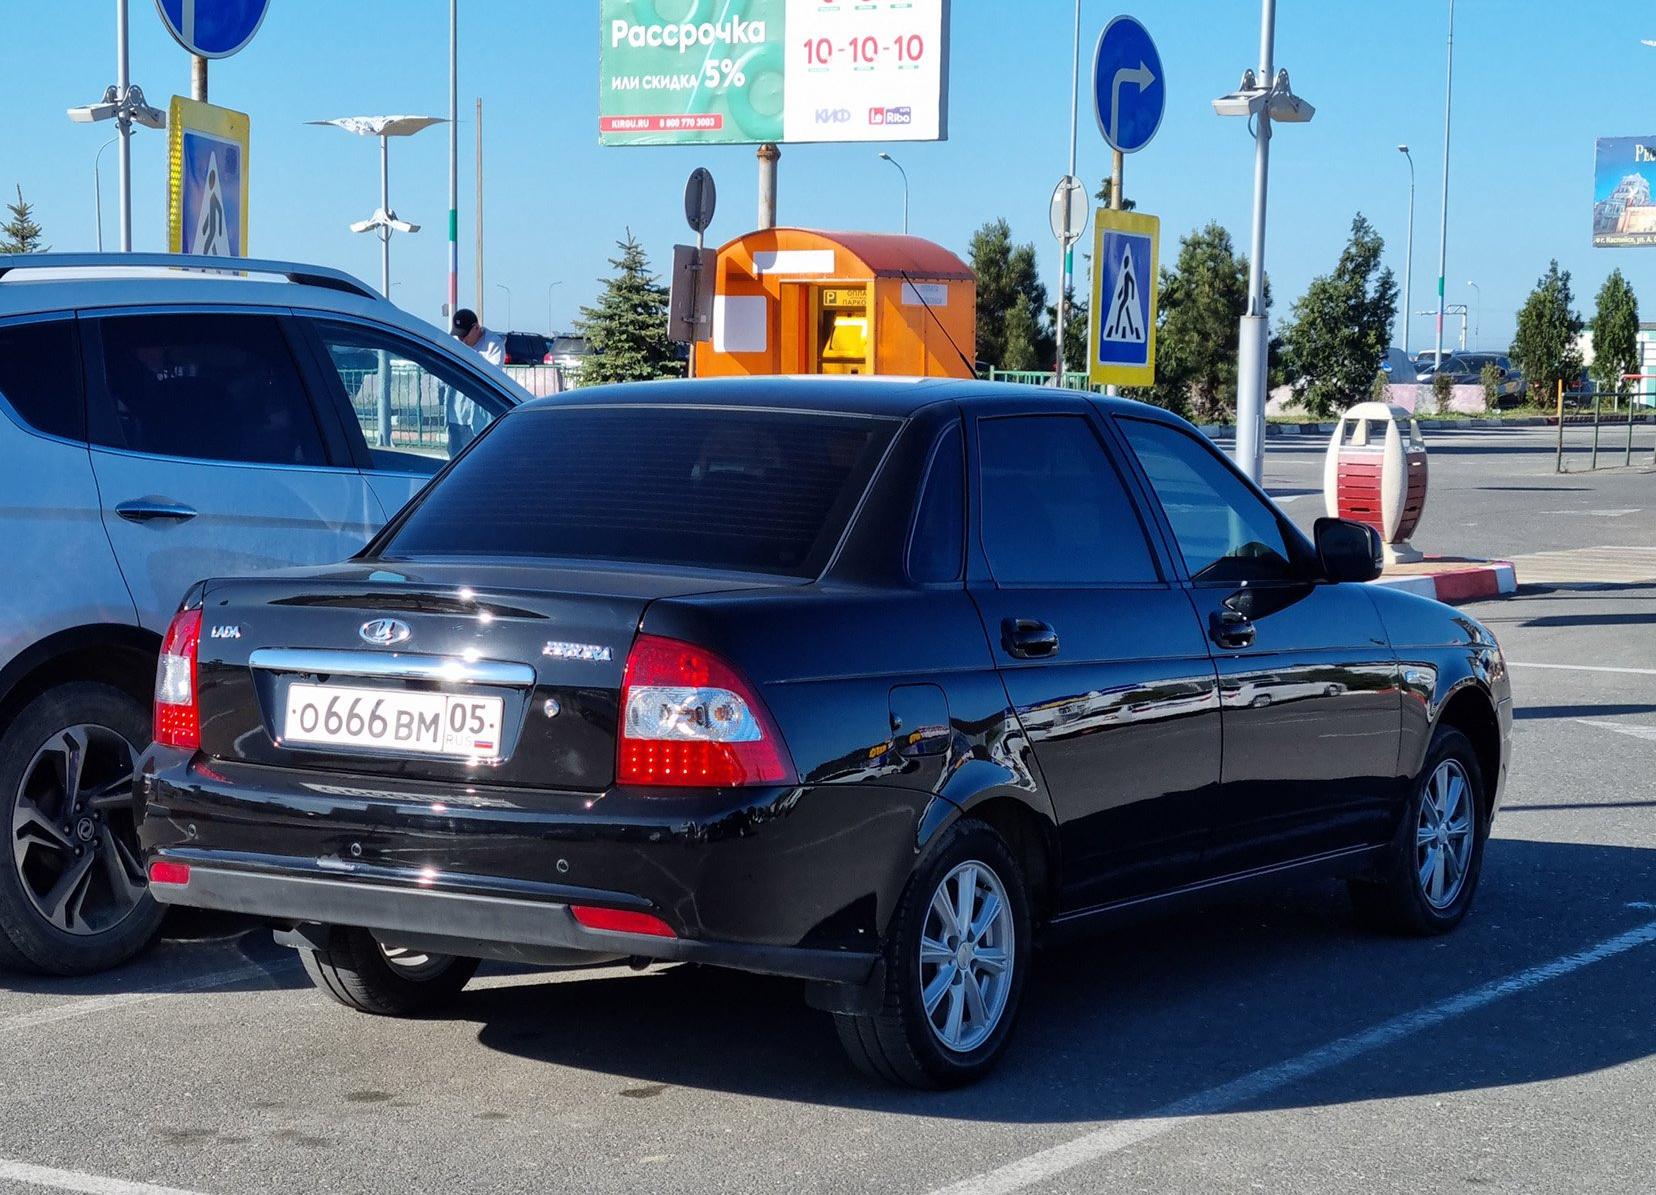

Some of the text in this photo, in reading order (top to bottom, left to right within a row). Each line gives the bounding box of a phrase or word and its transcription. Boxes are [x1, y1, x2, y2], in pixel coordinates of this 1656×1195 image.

[611, 14, 766, 53] Рассрочка
[611, 58, 746, 91] ИЛИ СКИДКА 5%
[211, 625, 241, 639] LADA
[449, 702, 486, 735] 05
